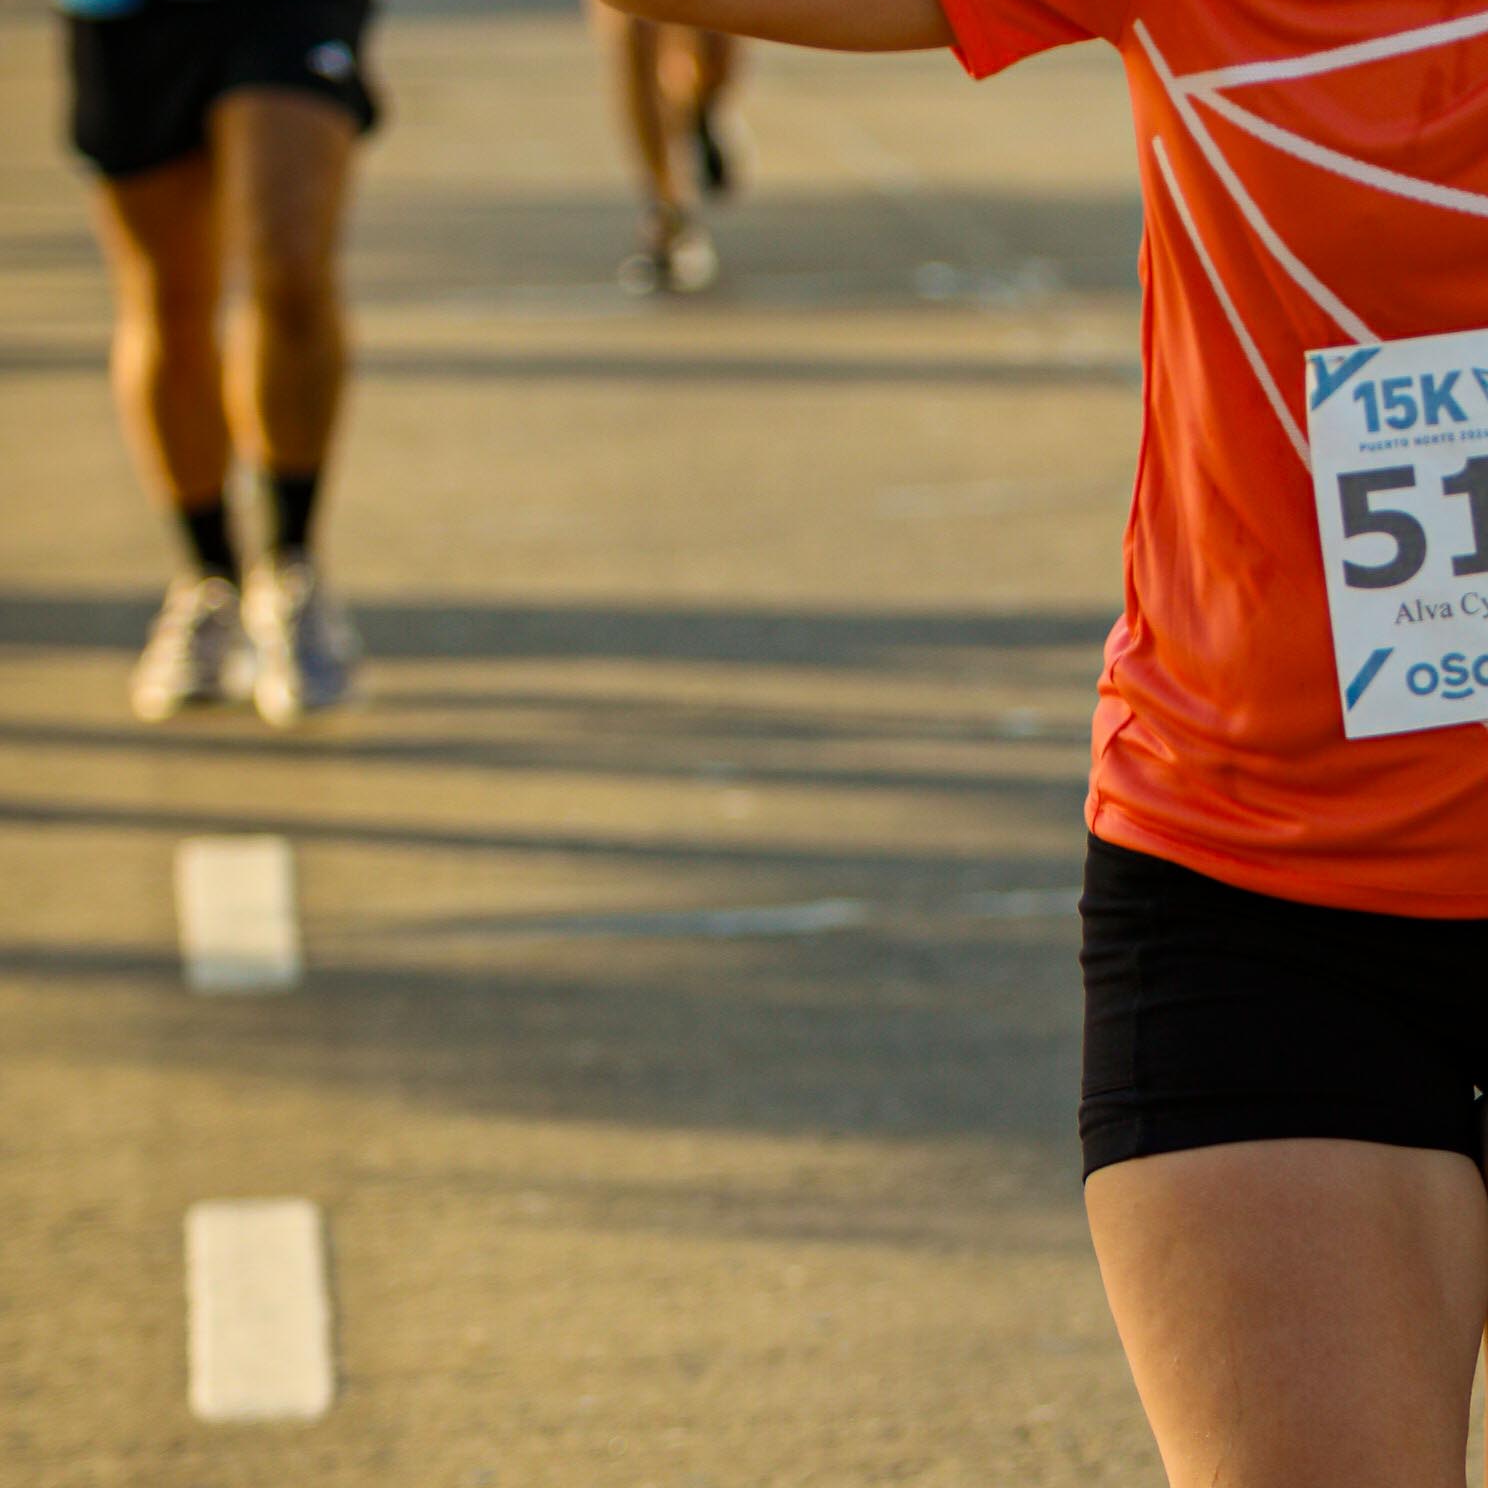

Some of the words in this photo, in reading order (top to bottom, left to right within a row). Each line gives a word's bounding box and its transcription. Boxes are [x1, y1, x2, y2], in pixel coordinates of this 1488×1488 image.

[1353, 369, 1468, 433] 15K
[1359, 438, 1409, 452] PUERTO
[1394, 599, 1453, 624] Alva
